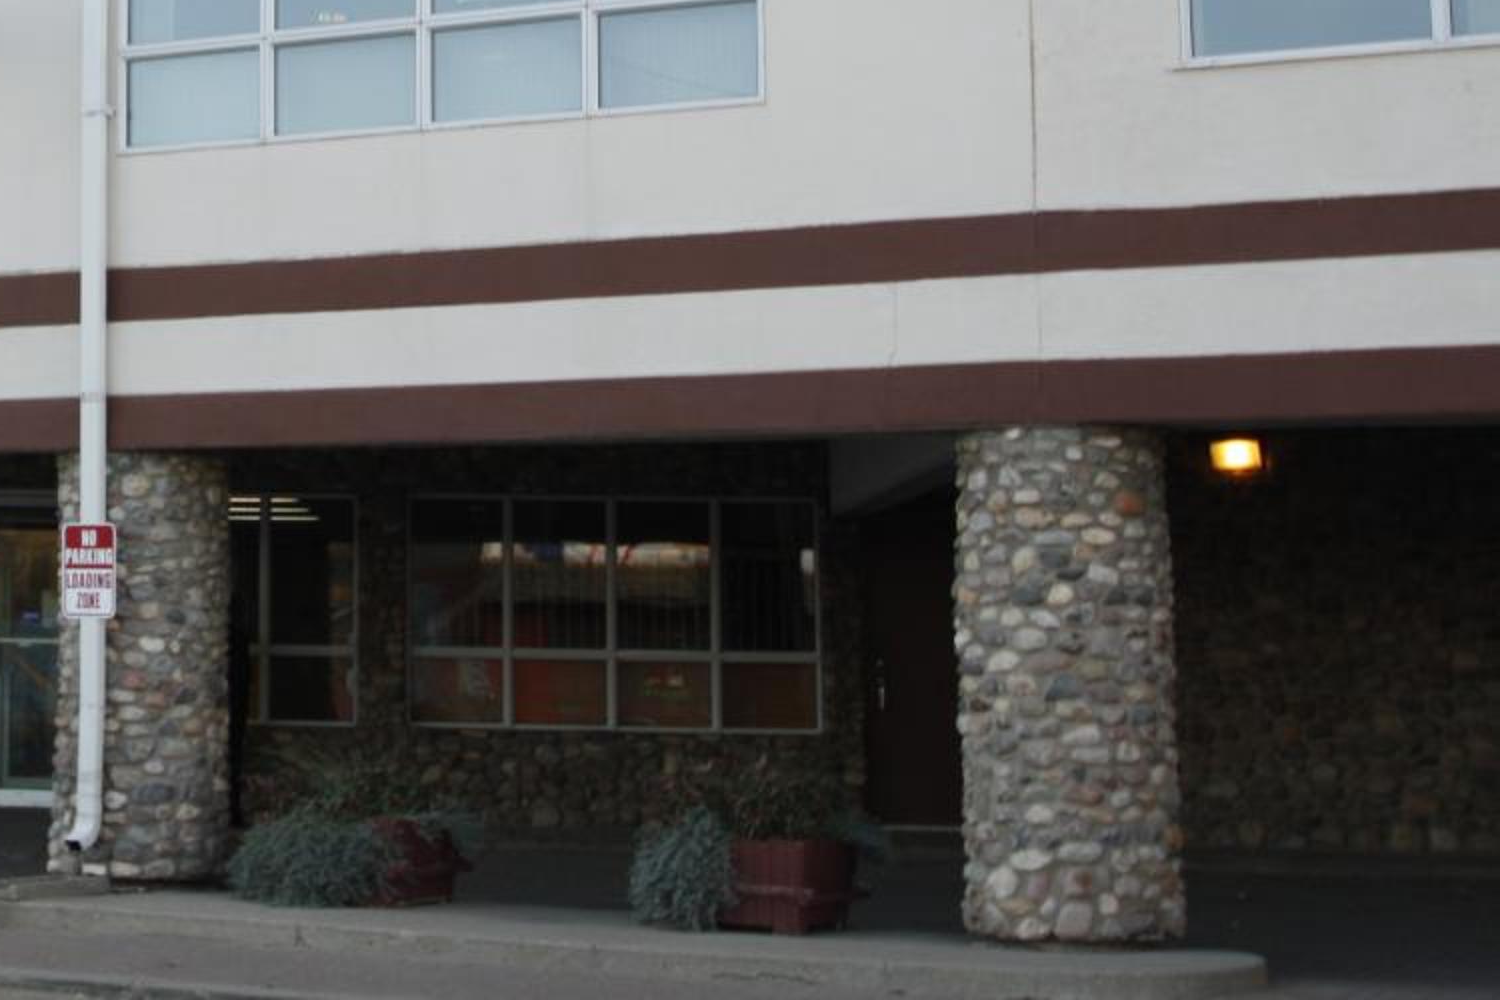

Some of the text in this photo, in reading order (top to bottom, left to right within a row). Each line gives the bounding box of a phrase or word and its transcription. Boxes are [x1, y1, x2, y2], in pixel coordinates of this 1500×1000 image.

[81, 530, 97, 547] NO
[66, 549, 113, 564] PARKING
[67, 572, 111, 588] LOADING
[77, 592, 100, 608] ZONE
